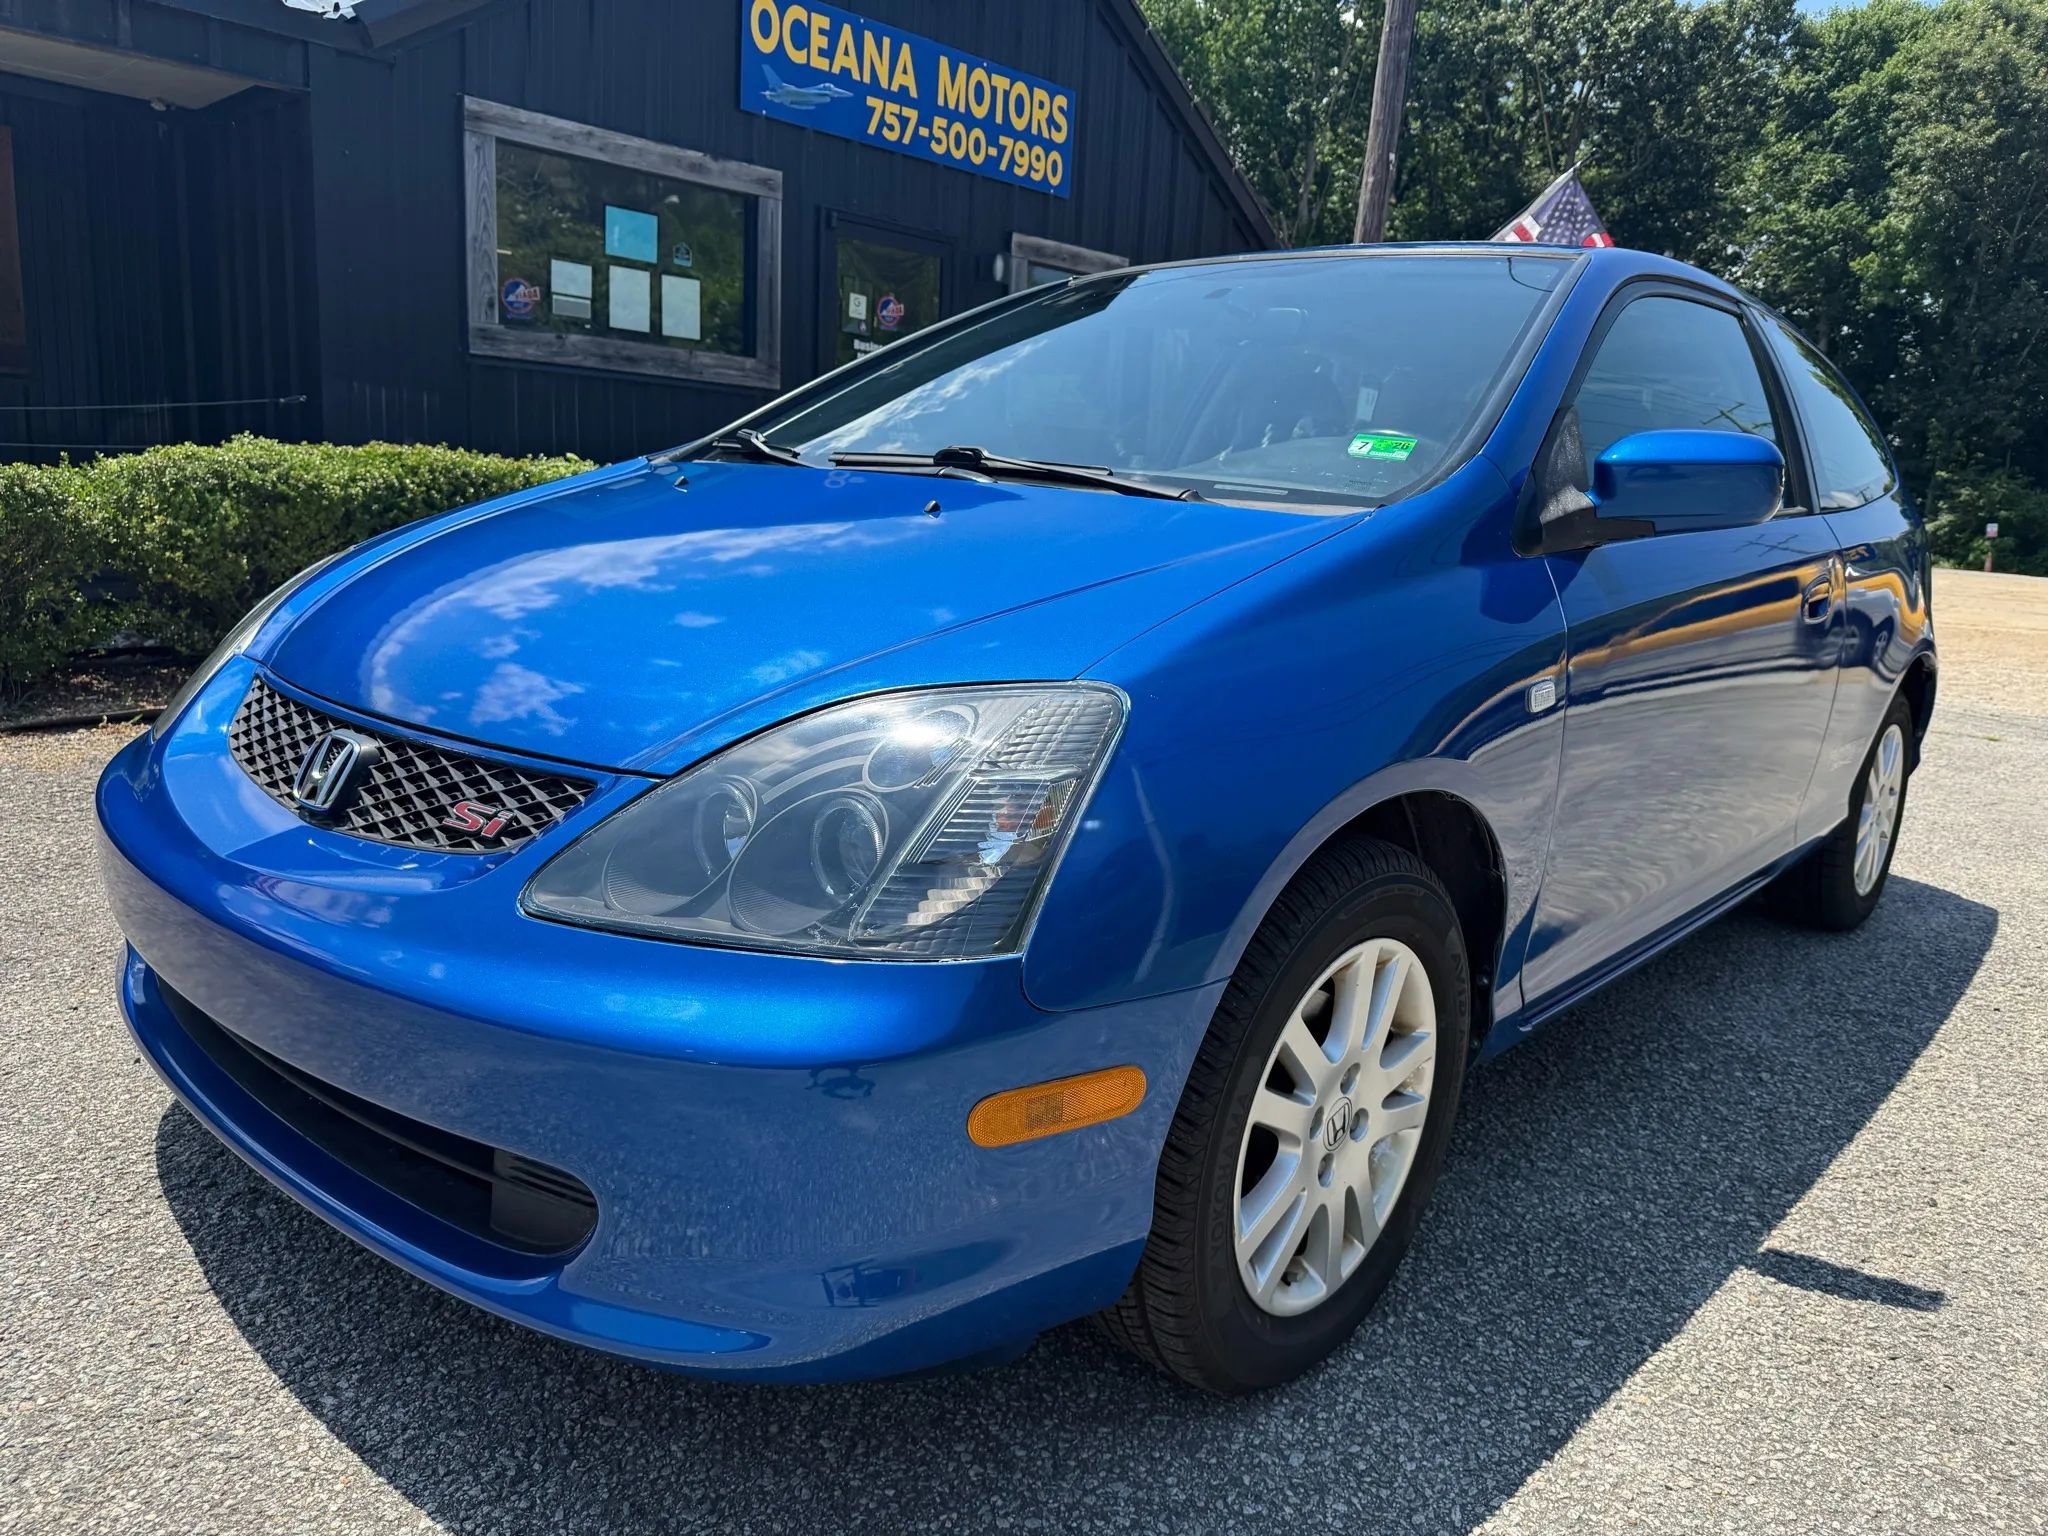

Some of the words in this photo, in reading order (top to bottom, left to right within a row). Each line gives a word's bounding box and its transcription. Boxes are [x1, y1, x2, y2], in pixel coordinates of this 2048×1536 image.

[750, 0, 918, 99] OCEANA
[937, 55, 1069, 144] MOTORS
[866, 95, 1063, 187] 757-500-7990
[1357, 441, 1370, 451] 7
[443, 801, 514, 839] Si
